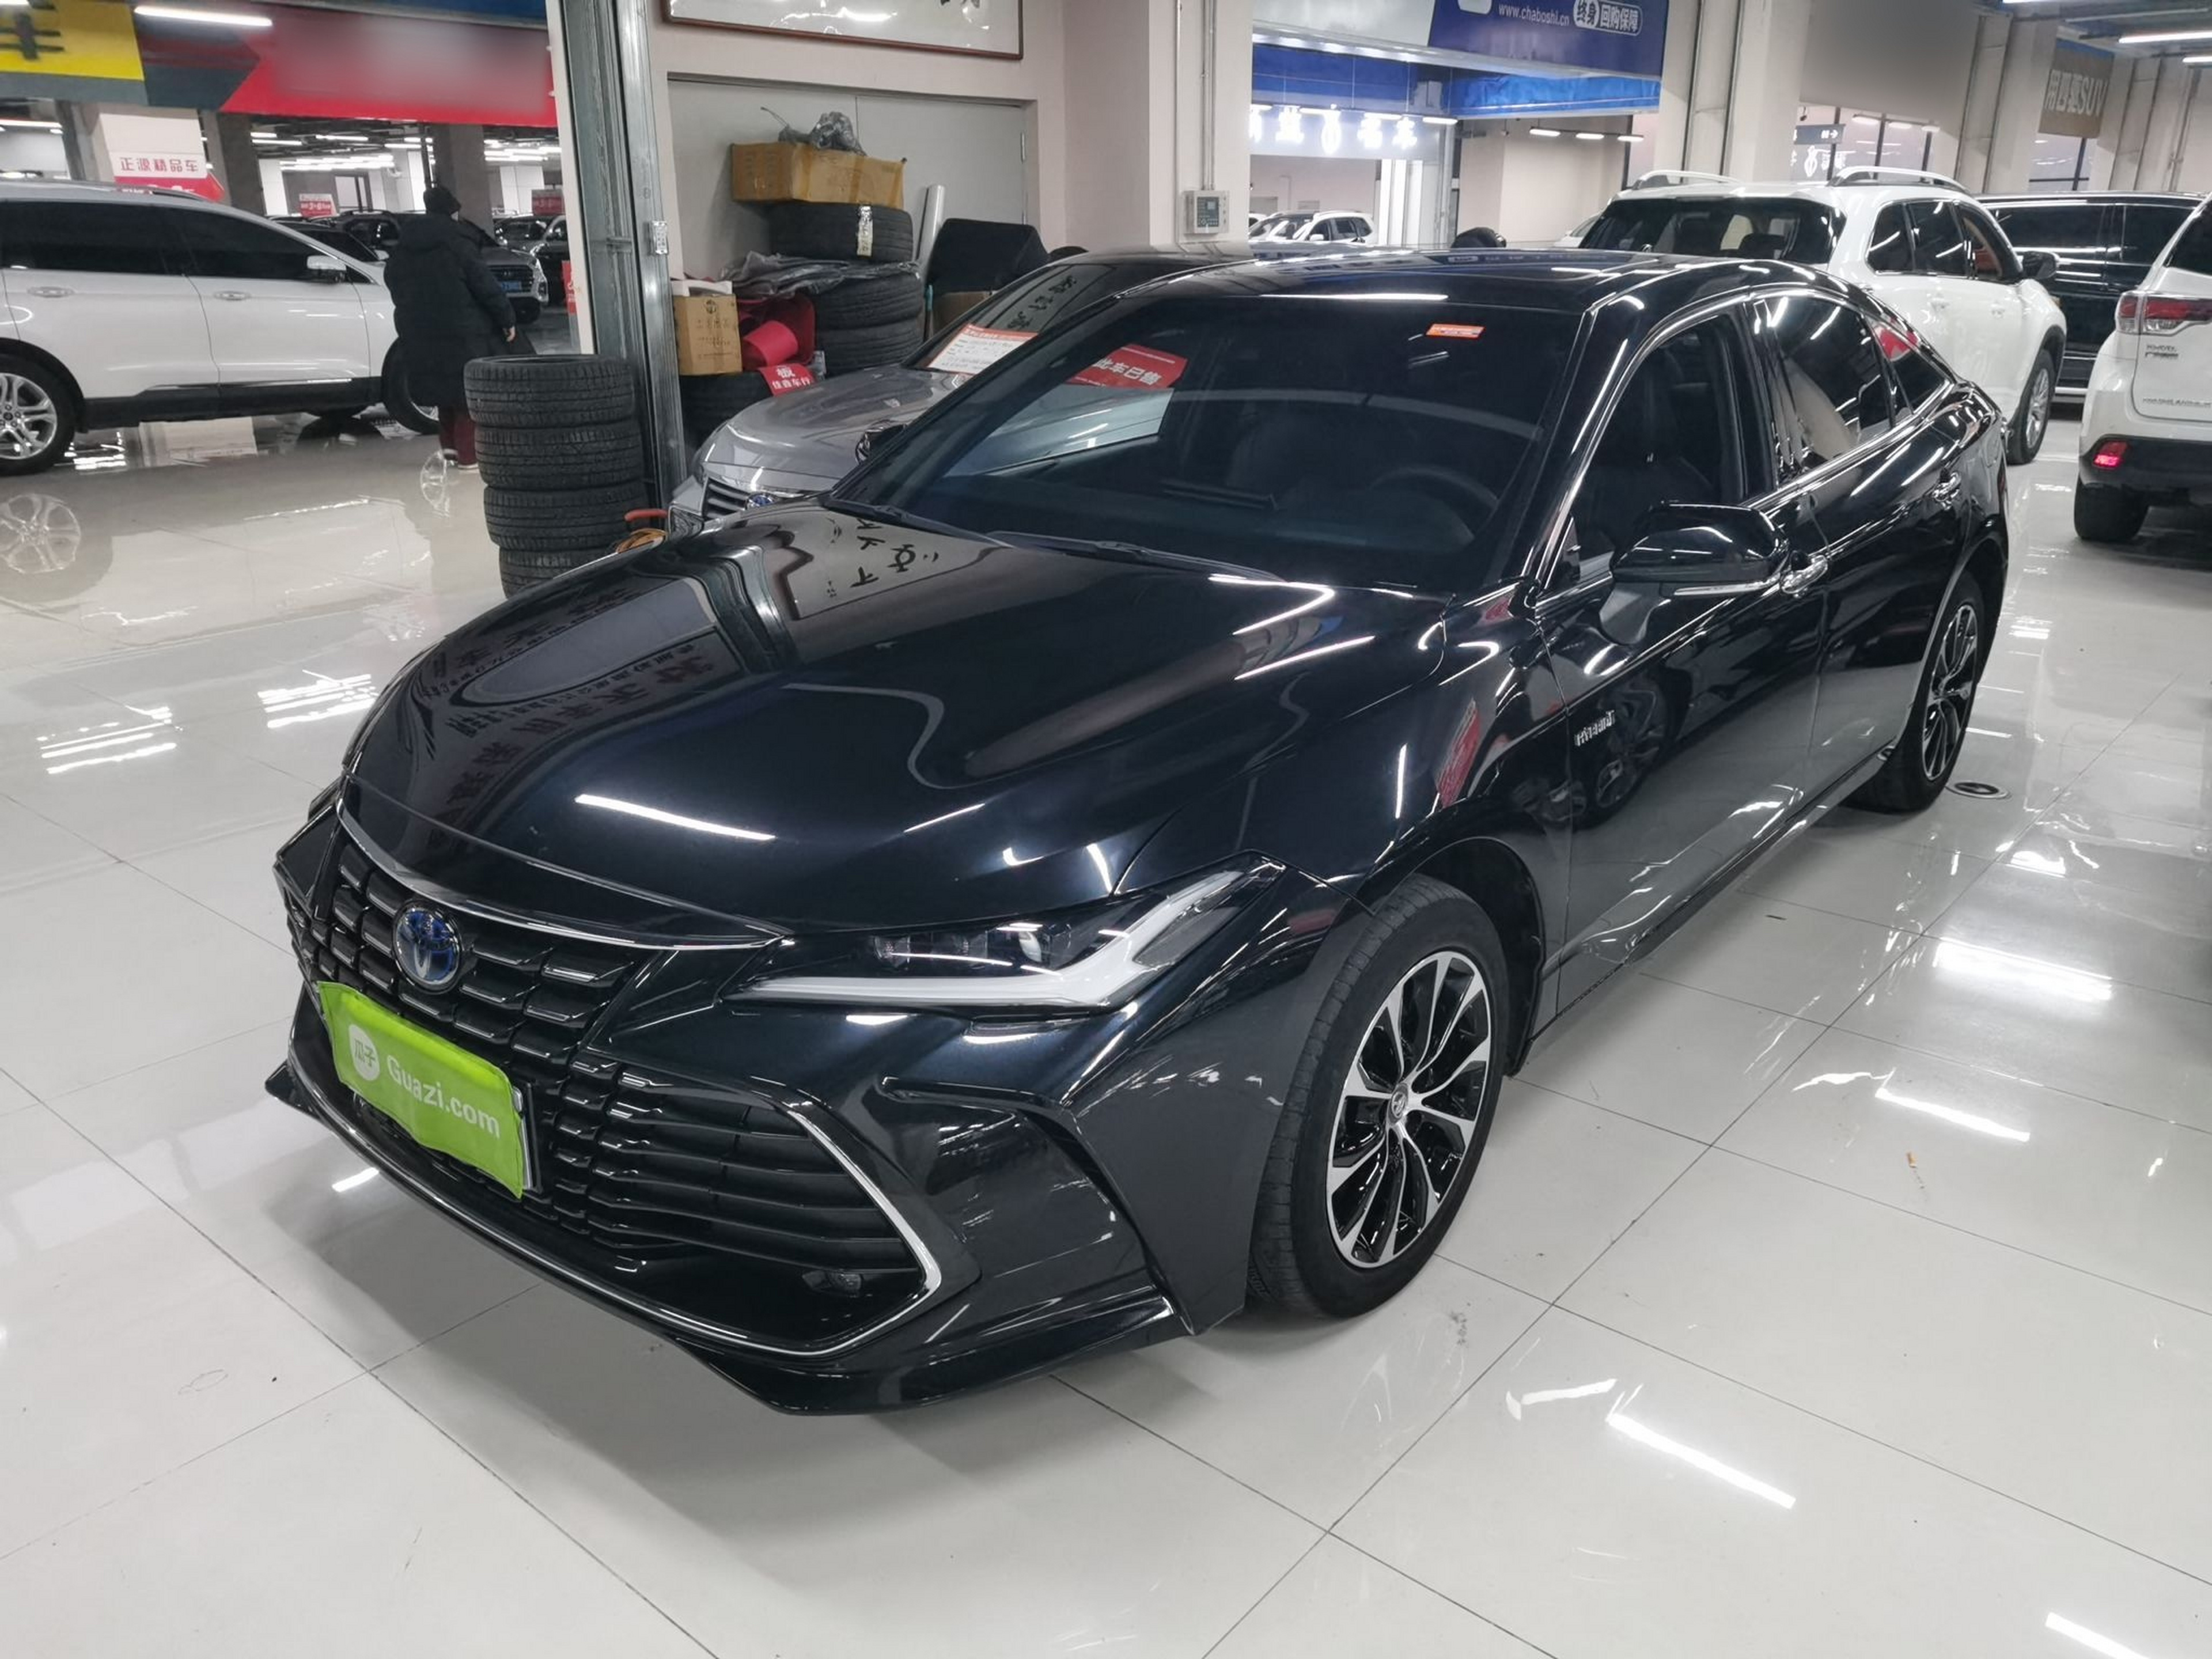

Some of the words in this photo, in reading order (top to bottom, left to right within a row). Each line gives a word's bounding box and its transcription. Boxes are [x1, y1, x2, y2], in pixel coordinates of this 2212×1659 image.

[1499, 3, 1570, 26] www.chaboshi.cn
[1577, 0, 1597, 25] 终身
[1600, 4, 1638, 32] 回购保障
[120, 157, 198, 172] 正源精品车
[1092, 358, 1162, 385] 此车已售
[354, 1038, 376, 1067] 瓜子
[387, 1054, 500, 1139] Guazi.com
